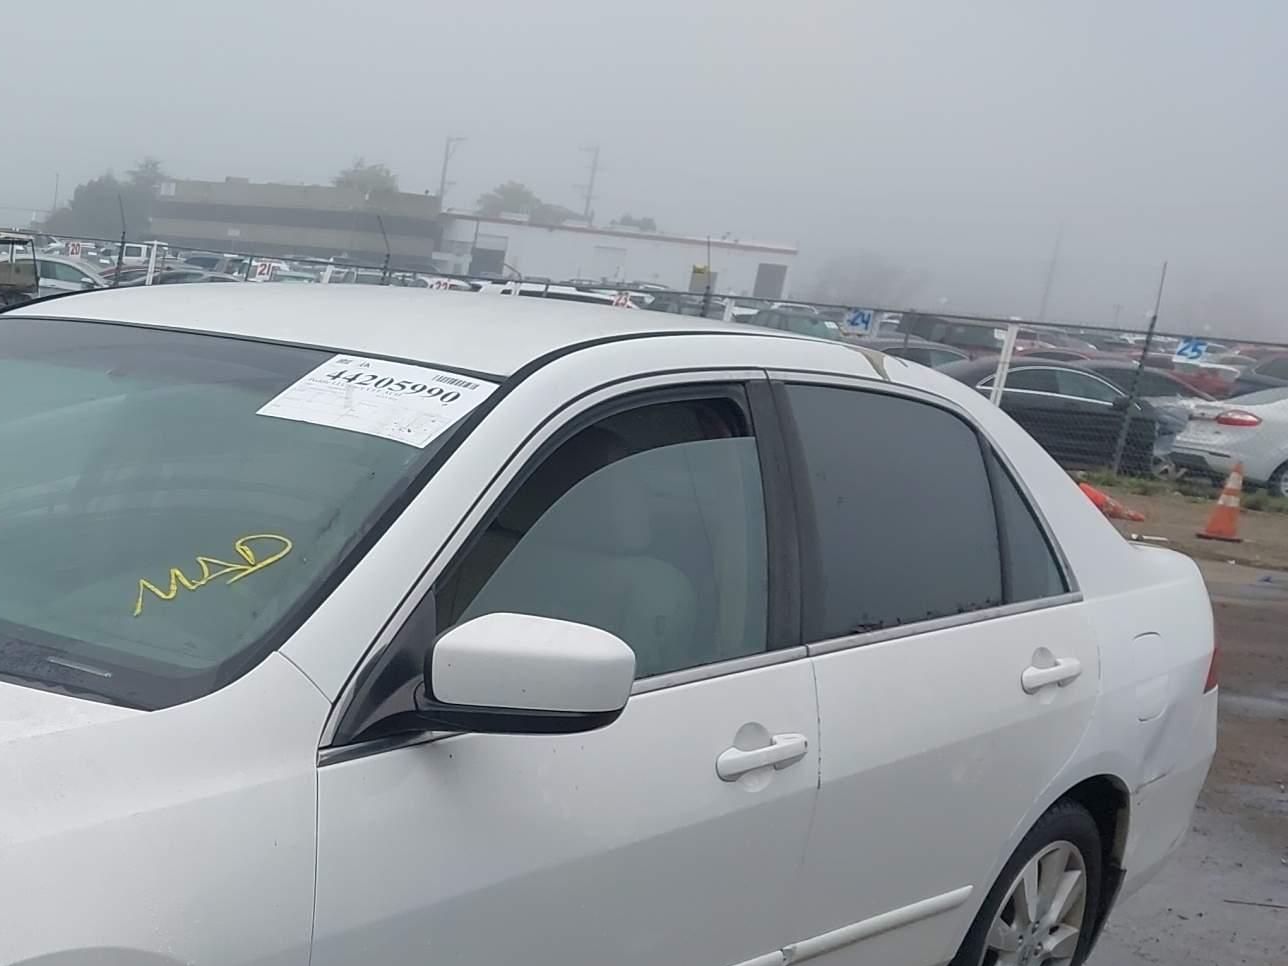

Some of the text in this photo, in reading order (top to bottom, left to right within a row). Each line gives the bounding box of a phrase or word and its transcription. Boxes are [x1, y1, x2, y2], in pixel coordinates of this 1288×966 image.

[70, 243, 80, 255] 20
[258, 263, 272, 276] 21
[847, 309, 871, 330] 24
[1176, 336, 1209, 360] 25
[326, 368, 462, 404] 44205990
[132, 533, 294, 617] MAD
